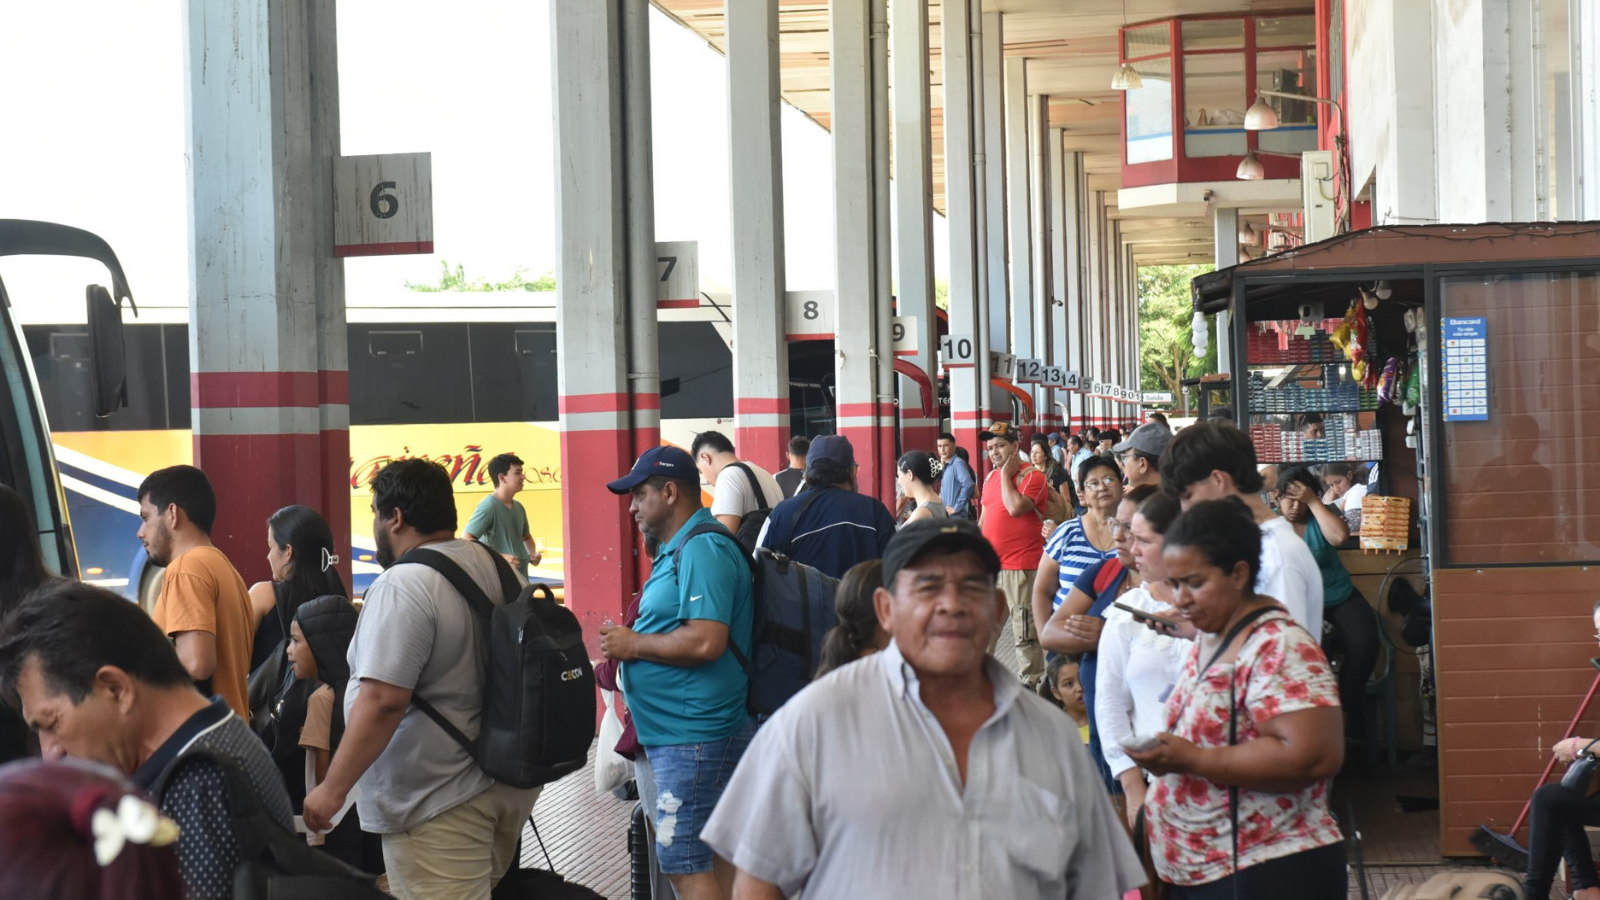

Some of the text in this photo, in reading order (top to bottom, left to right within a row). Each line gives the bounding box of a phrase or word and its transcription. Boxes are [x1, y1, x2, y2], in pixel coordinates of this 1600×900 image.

[370, 181, 399, 219] 6
[657, 256, 677, 282] 7
[803, 301, 819, 320] 8
[893, 323, 905, 342] 9
[944, 338, 972, 360] 10
[991, 355, 1012, 374] 11
[1020, 362, 1040, 377] 12
[1042, 368, 1061, 382] 13
[1061, 374, 1077, 386] 14
